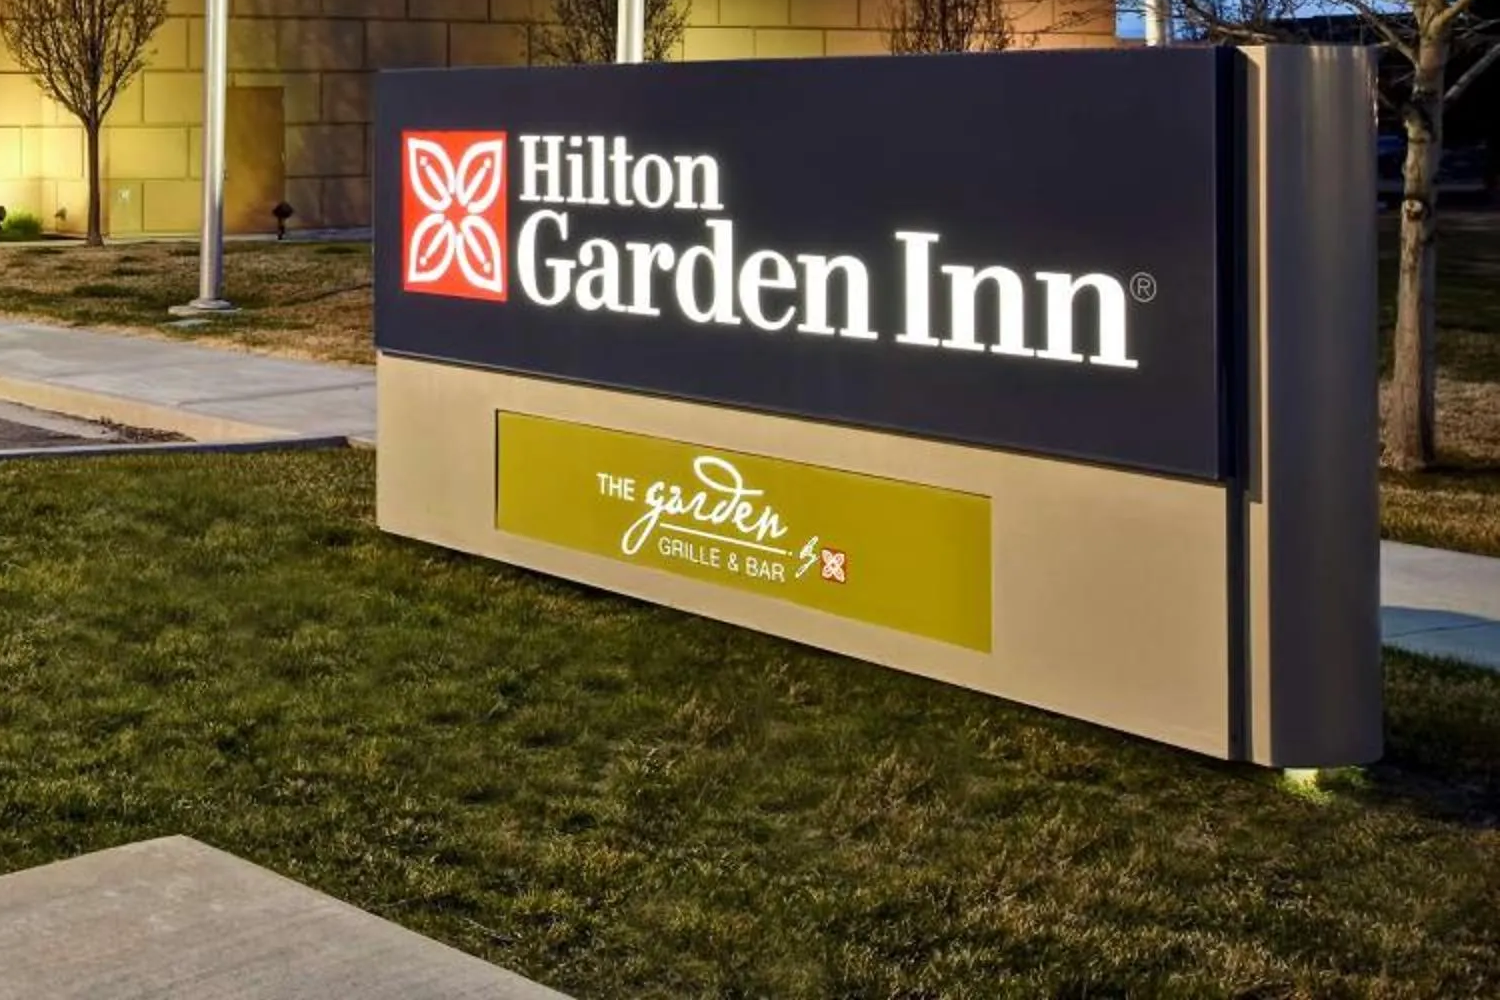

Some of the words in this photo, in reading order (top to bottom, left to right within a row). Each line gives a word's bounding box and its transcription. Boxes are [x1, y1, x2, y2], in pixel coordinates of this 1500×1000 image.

[518, 134, 725, 211] Hilton
[517, 209, 879, 340] Garden
[596, 472, 636, 502] THE
[621, 455, 789, 555] garden
[658, 535, 721, 569] GRILLE
[727, 551, 740, 572] &
[745, 555, 786, 583] BAR
